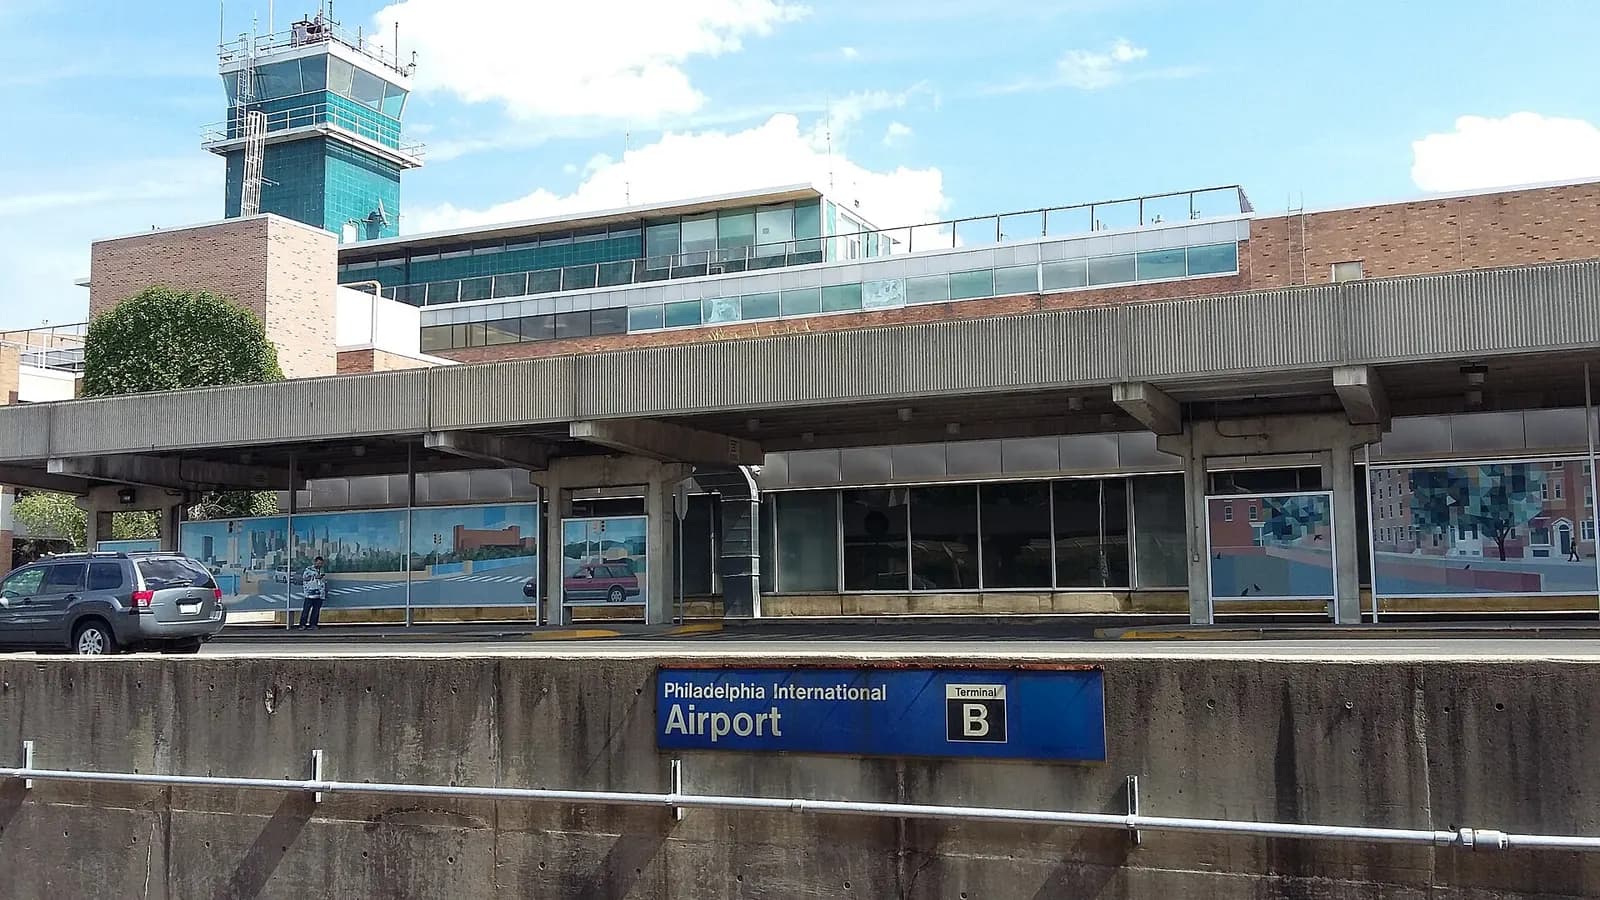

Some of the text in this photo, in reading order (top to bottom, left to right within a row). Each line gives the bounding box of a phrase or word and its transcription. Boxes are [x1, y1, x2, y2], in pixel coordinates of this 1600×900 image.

[664, 682, 887, 702] Philadelphia International
[955, 687, 998, 697] Terminal
[664, 704, 782, 742] Airport
[963, 703, 989, 736] B
